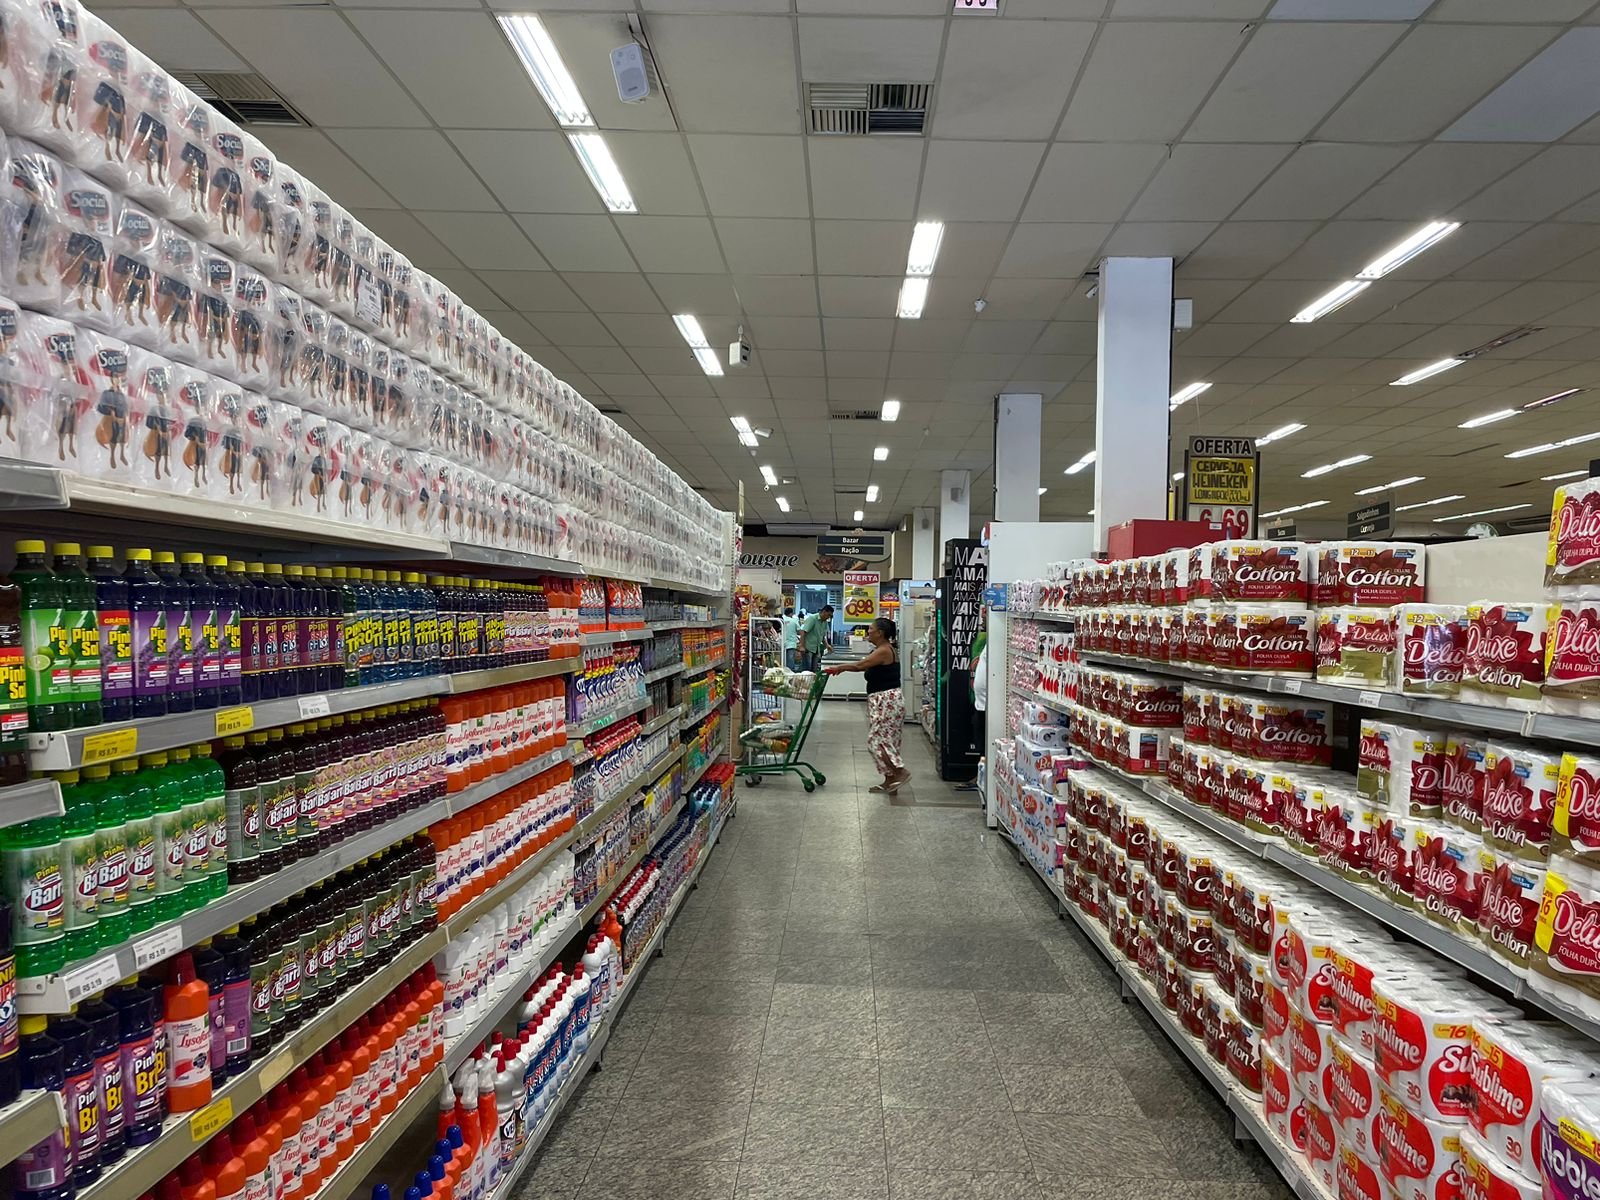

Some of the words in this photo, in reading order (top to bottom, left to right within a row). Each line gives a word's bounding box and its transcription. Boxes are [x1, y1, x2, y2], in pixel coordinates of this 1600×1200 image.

[1193, 439, 1251, 455] OFERTA
[1196, 461, 1246, 474] CERVEJA
[1192, 473, 1248, 489] HEINEKEN
[845, 574, 879, 582] OFERTA
[1234, 565, 1297, 584] Cotton
[1345, 568, 1413, 587] Cotton
[1413, 614, 1424, 623] 12
[1243, 633, 1304, 652] Cotton
[1573, 662, 1599, 673] DUPLA
[1479, 667, 1522, 689] Cotton
[1135, 700, 1182, 713] Cotton
[1259, 725, 1322, 746] Cotton
[1490, 924, 1529, 957] Cotton
[1558, 946, 1579, 962] FOLHA
[1343, 960, 1354, 973] 15
[1384, 1003, 1396, 1018] 15
[1360, 1030, 1373, 1046] 30
[1450, 1024, 1467, 1039] 16
[1341, 1056, 1352, 1070] 15
[1488, 1048, 1501, 1063] 15
[1308, 1080, 1319, 1095] 30
[1406, 1081, 1422, 1101] 30
[1470, 1051, 1524, 1119] Sublime
[1394, 1105, 1408, 1120] 15
[1355, 1127, 1367, 1145] 30
[1380, 1108, 1429, 1172] Sublime
[1506, 1136, 1522, 1155] 30
[1347, 1150, 1359, 1167] 15
[1476, 1168, 1488, 1183] 15
